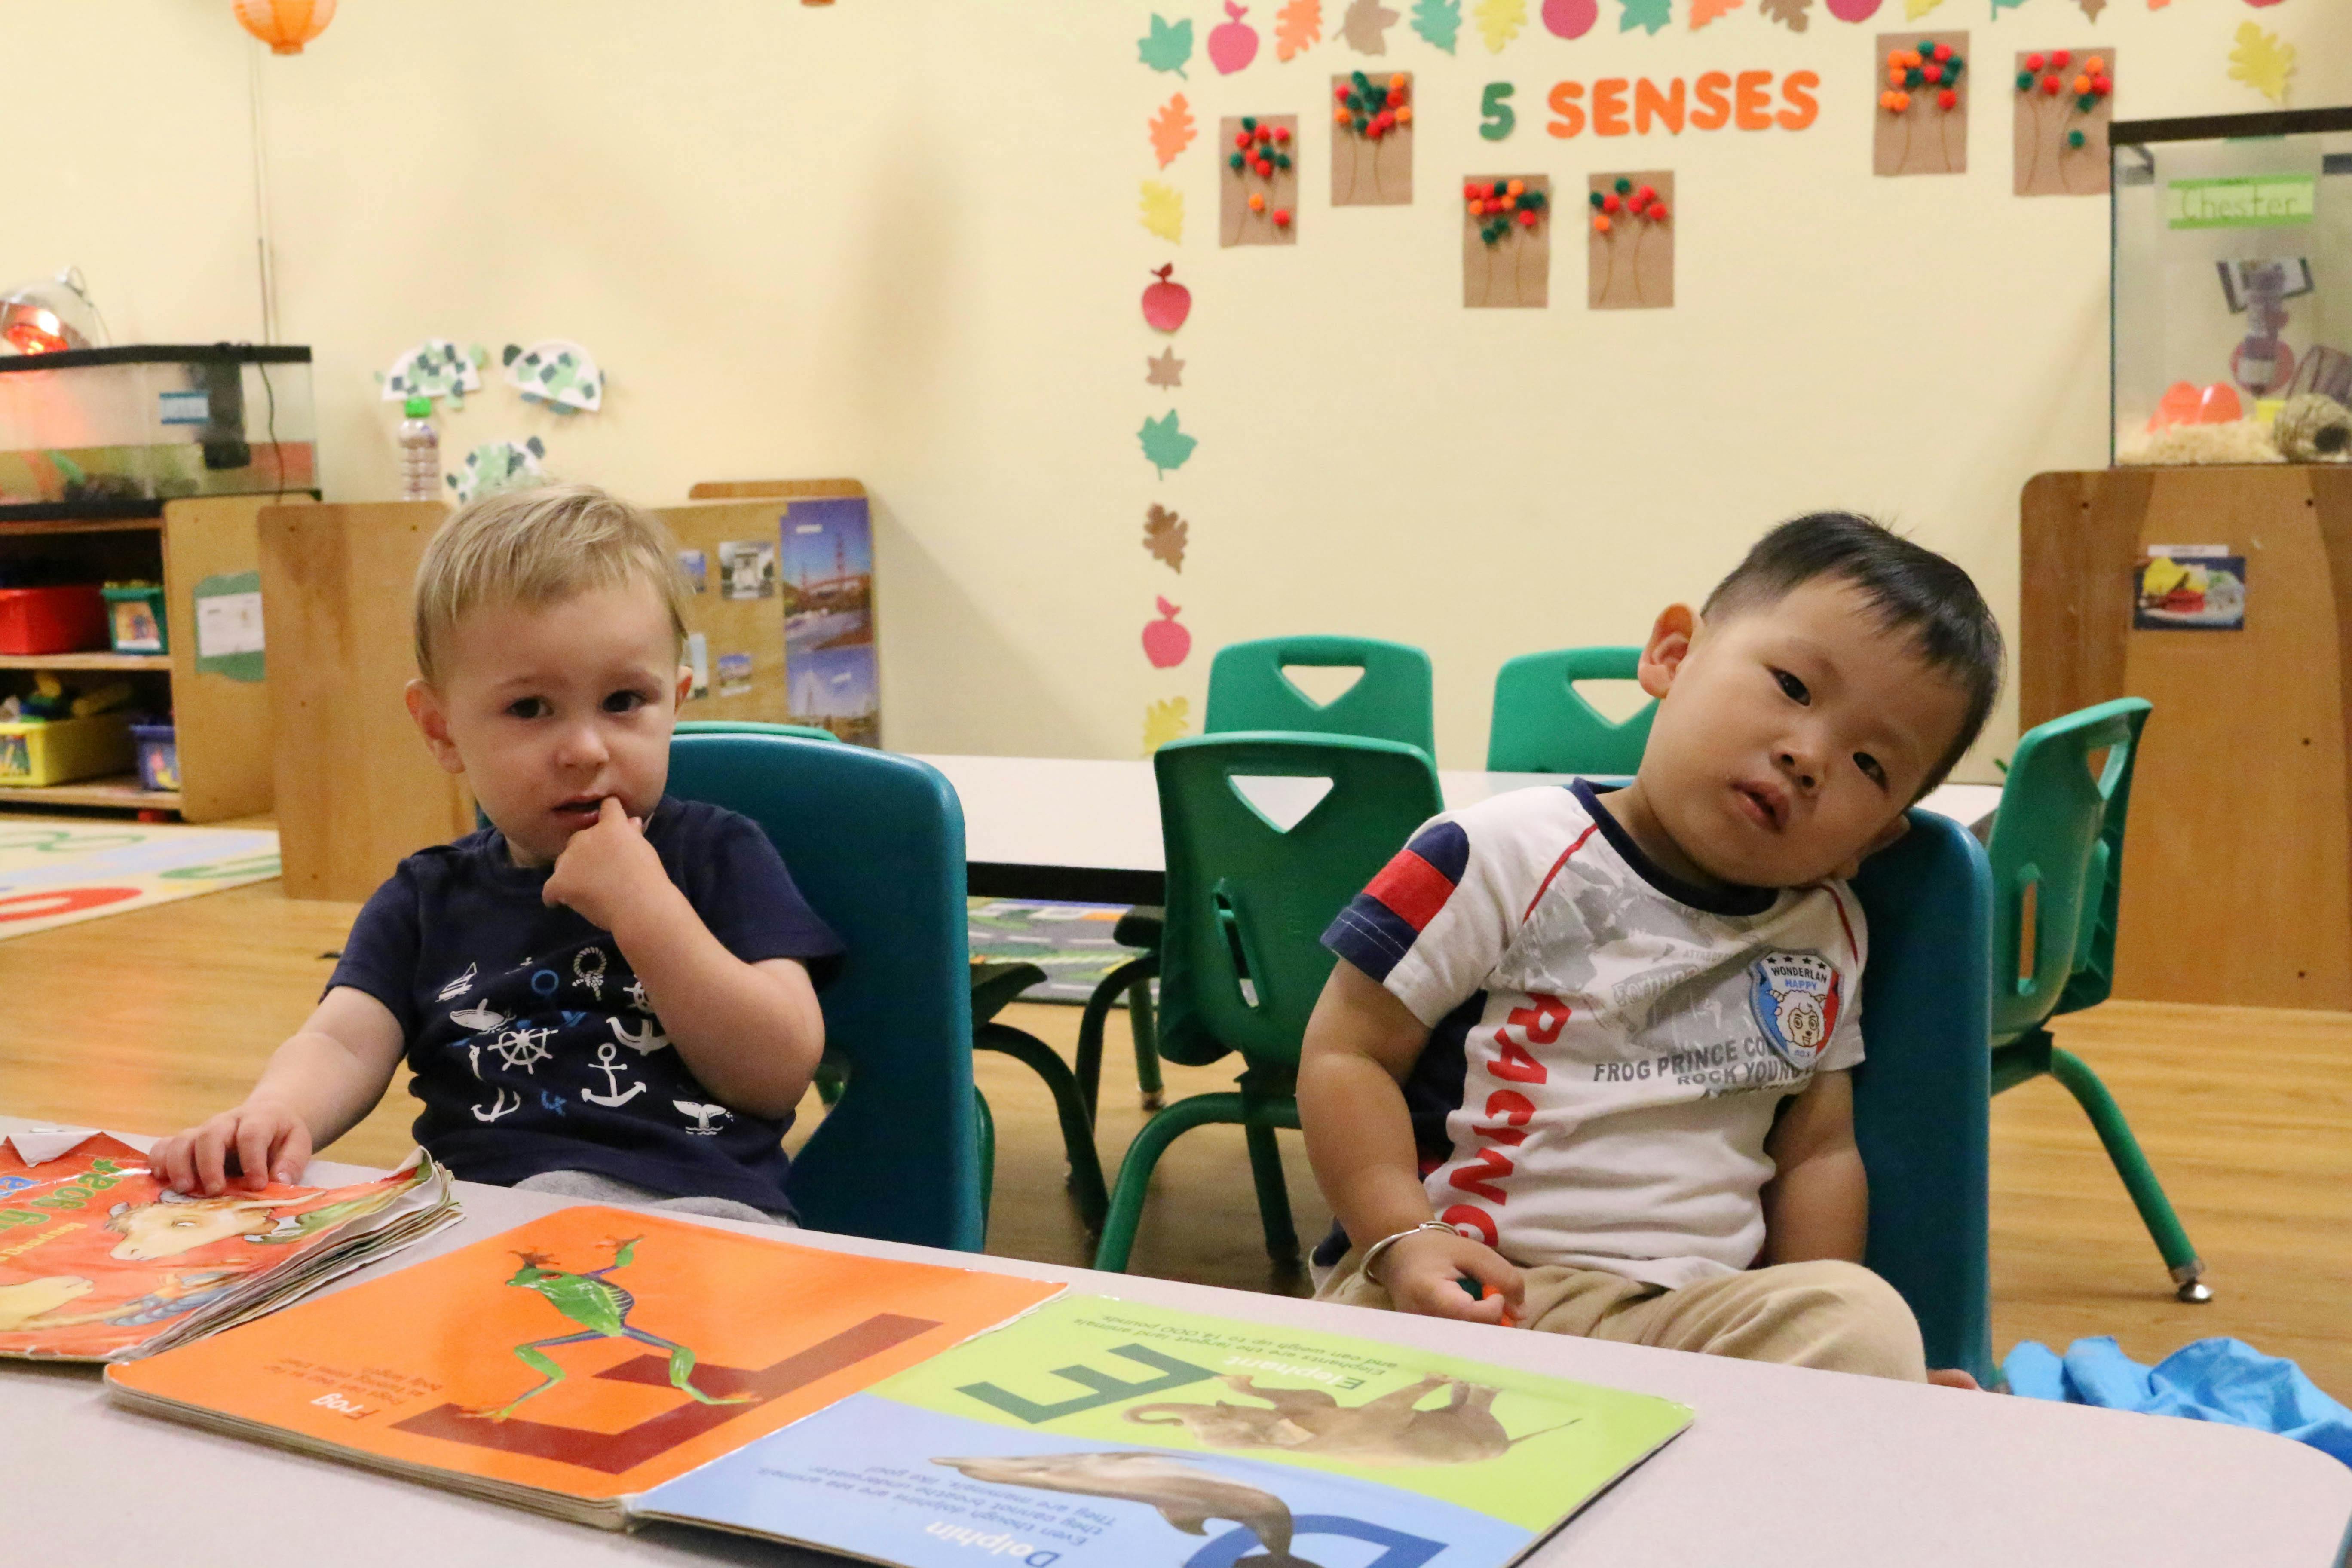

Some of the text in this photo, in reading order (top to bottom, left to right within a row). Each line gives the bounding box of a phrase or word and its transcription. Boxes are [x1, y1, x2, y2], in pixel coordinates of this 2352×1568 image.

[1479, 70, 1820, 141] 5 SENSES
[2182, 184, 2297, 219] Chester
[1785, 978, 1818, 990] HAPPY
[1593, 1060, 1651, 1082] FROG
[1657, 1039, 1738, 1077] PRINCE
[1678, 1065, 1737, 1085] ROCK
[1448, 992, 1572, 1246] RACING
[29, 1158, 129, 1210] goat
[1074, 1318, 1132, 1333] animals
[1133, 1329, 1169, 1340] land
[1175, 1336, 1230, 1349] largest
[1235, 1345, 1263, 1353] the
[1252, 1338, 1273, 1346] up
[1277, 1343, 1325, 1354] weigh
[1302, 1354, 1386, 1376] Elephants
[1330, 1351, 1361, 1361] can
[1363, 1358, 1398, 1368] and
[1223, 1355, 1366, 1390] Elephant
[954, 1343, 1224, 1424] E
[310, 1393, 382, 1420] Frog
[971, 1510, 1035, 1531] though
[991, 1502, 1056, 1522] cannot
[1075, 1507, 1116, 1526] They
[1060, 1517, 1103, 1535] they
[926, 1521, 1061, 1568] Dolphin
[1040, 1528, 1088, 1546] Even
